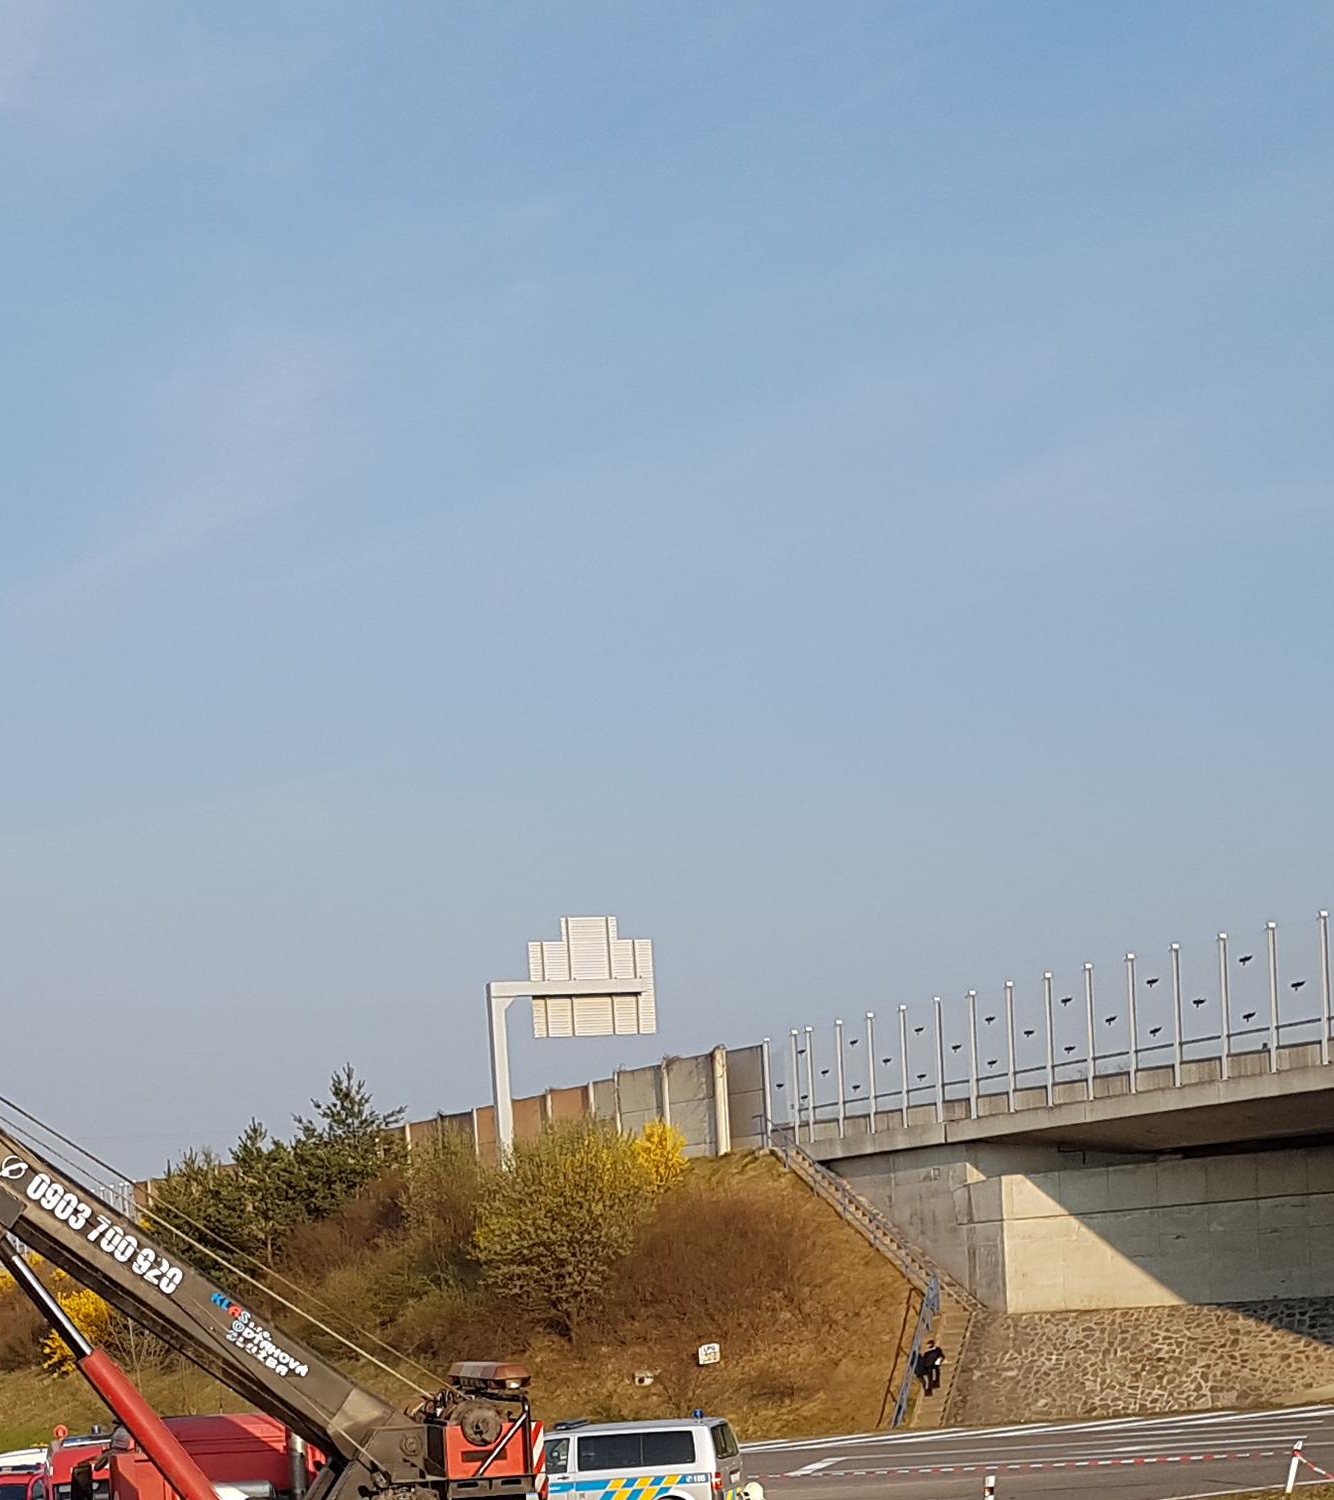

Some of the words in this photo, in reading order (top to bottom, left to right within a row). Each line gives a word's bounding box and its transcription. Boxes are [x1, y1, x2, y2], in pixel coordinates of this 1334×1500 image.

[26, 1173, 92, 1230] 0903
[87, 1214, 138, 1263] 700
[132, 1248, 183, 1295] 920
[210, 1292, 251, 1323] KLAS
